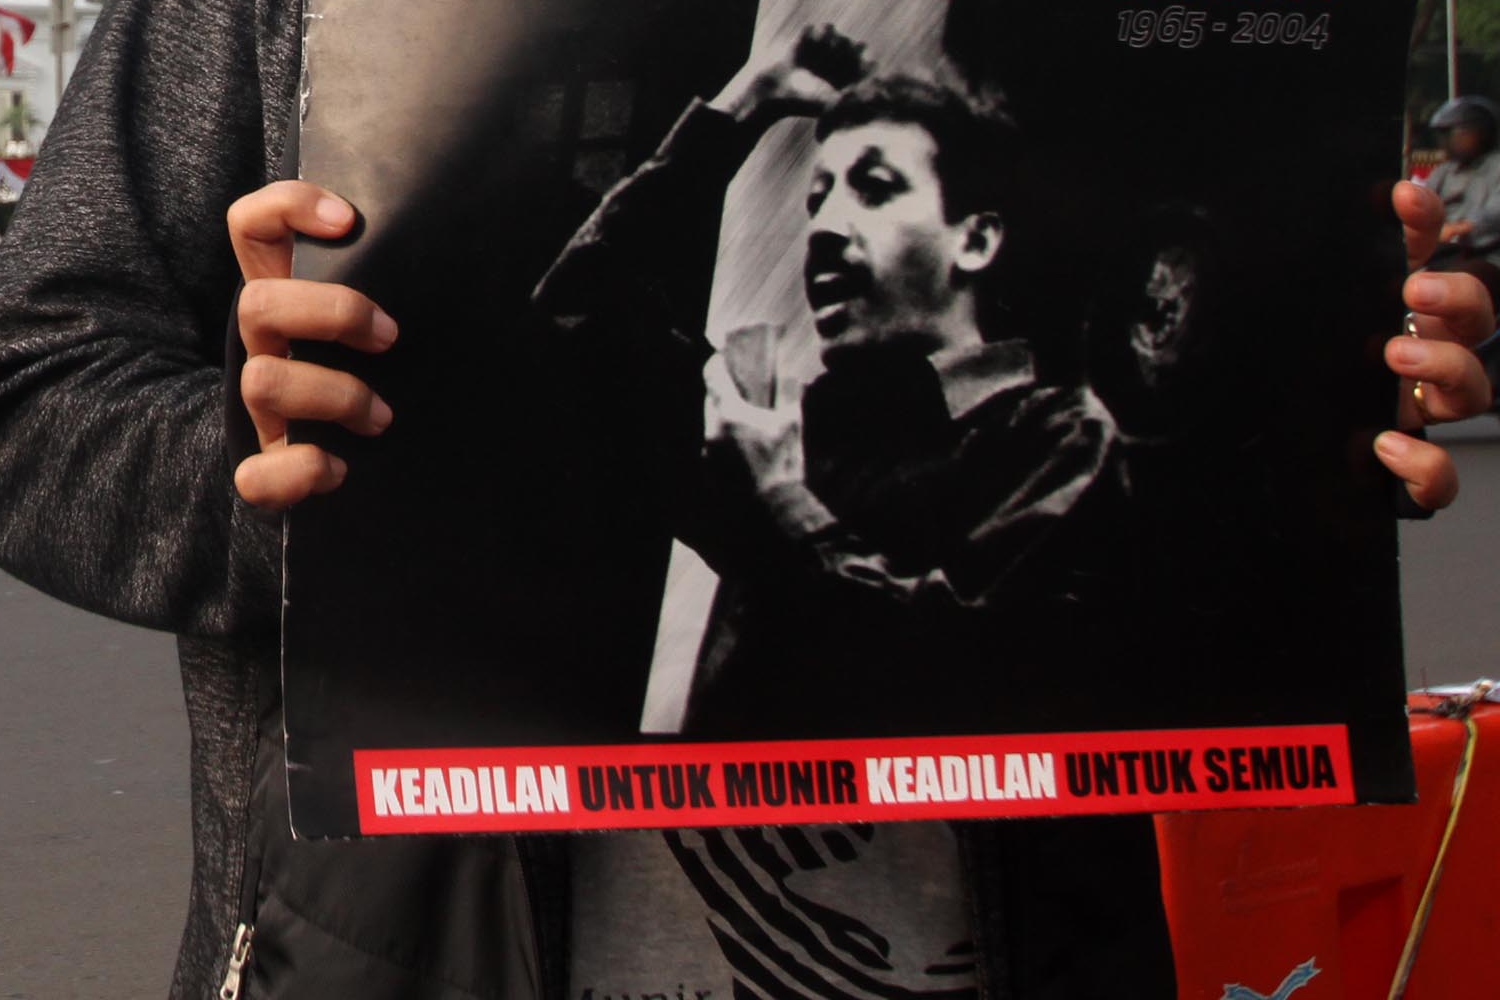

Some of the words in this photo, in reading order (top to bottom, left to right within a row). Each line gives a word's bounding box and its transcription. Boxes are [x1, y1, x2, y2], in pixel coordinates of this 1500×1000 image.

[1117, 5, 1207, 49] 1965
[1231, 11, 1330, 50] 2004
[371, 766, 570, 816] KEADILAN
[577, 764, 714, 811] UNTUK
[722, 759, 858, 808] MUNIR
[866, 753, 1057, 804] KEADILAN
[1065, 749, 1198, 797] UNTUK
[1204, 745, 1337, 793] SEMUA
